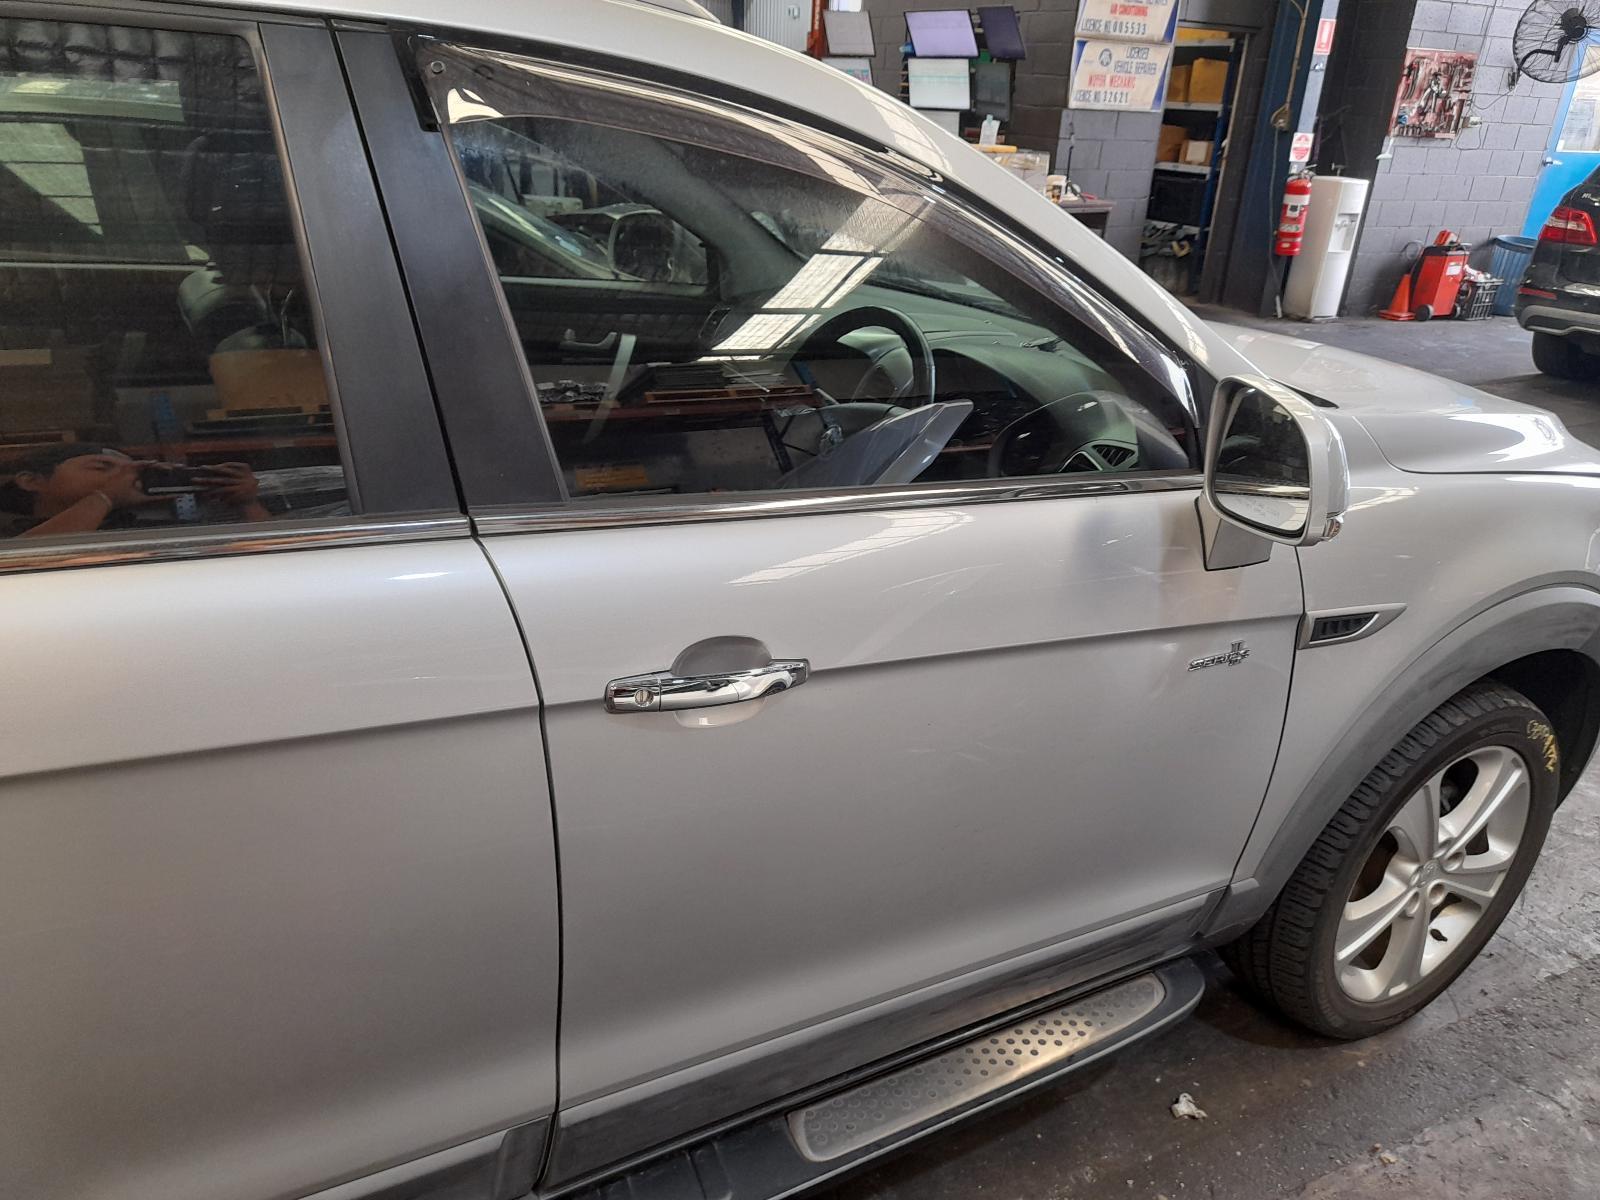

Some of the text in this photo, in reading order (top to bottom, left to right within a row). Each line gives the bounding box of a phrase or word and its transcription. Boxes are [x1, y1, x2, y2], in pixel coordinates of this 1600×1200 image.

[1114, 61, 1133, 74] VEHICLE
[1088, 74, 1136, 88] MOTOR MECHANIC
